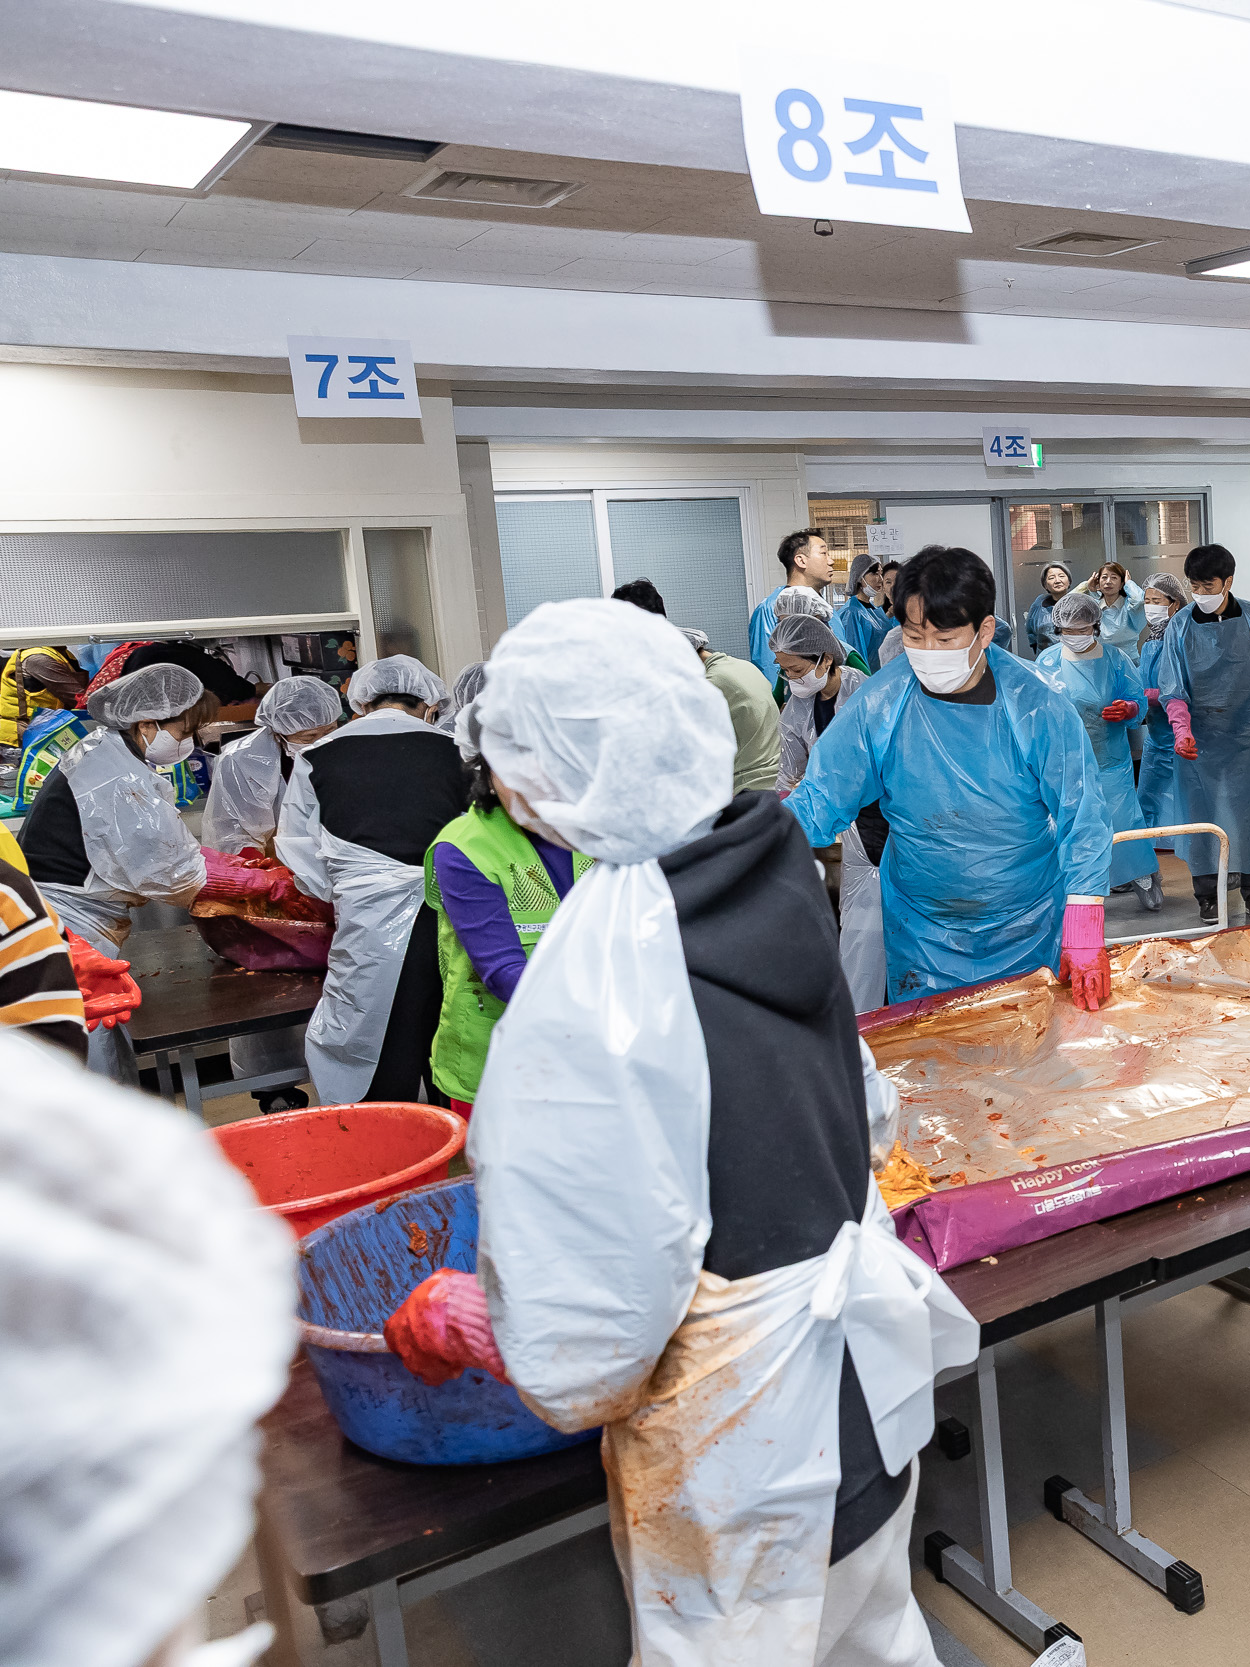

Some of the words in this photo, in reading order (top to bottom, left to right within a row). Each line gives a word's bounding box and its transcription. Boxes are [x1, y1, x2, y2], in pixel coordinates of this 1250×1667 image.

[775, 88, 939, 193] 8조
[305, 354, 406, 400] 7조
[989, 435, 1028, 458] 4조
[1010, 1169, 1063, 1192] Happy
[1065, 1158, 1102, 1175] lock
